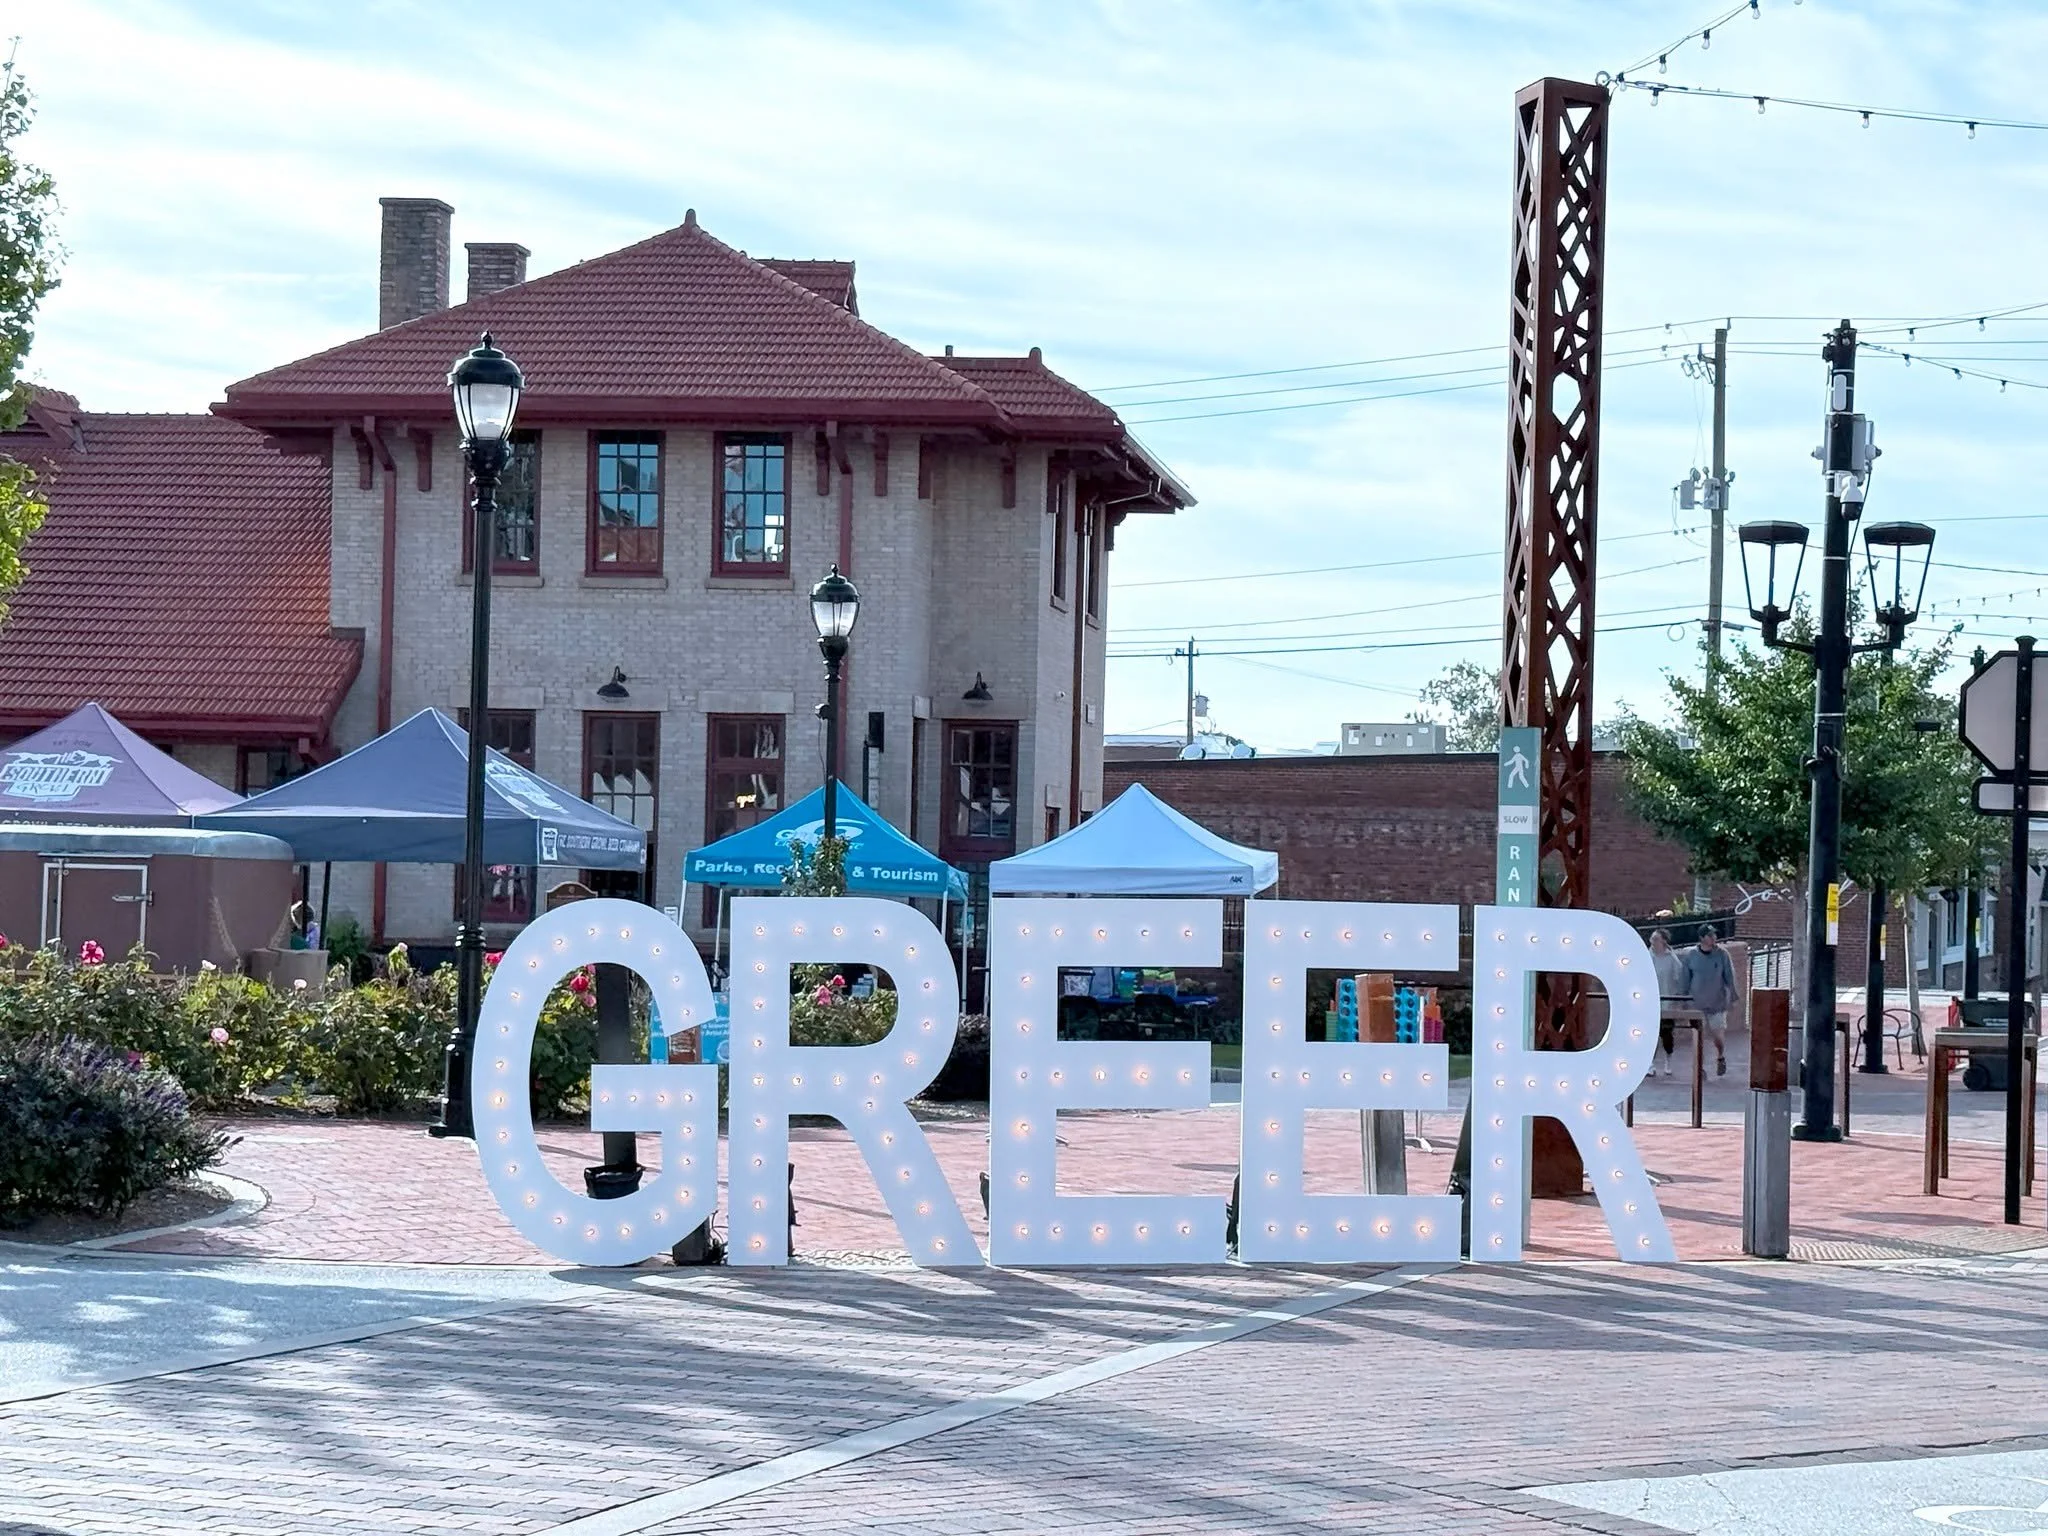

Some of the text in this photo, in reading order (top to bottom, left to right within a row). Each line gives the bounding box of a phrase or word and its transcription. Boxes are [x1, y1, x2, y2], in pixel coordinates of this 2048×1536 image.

[5, 766, 105, 785] SOUTHERN
[1503, 815, 1528, 823] SLOW
[694, 859, 748, 877] Parks,
[851, 866, 865, 878] &
[870, 867, 939, 882] Tourism
[471, 896, 1676, 1268] GREER
